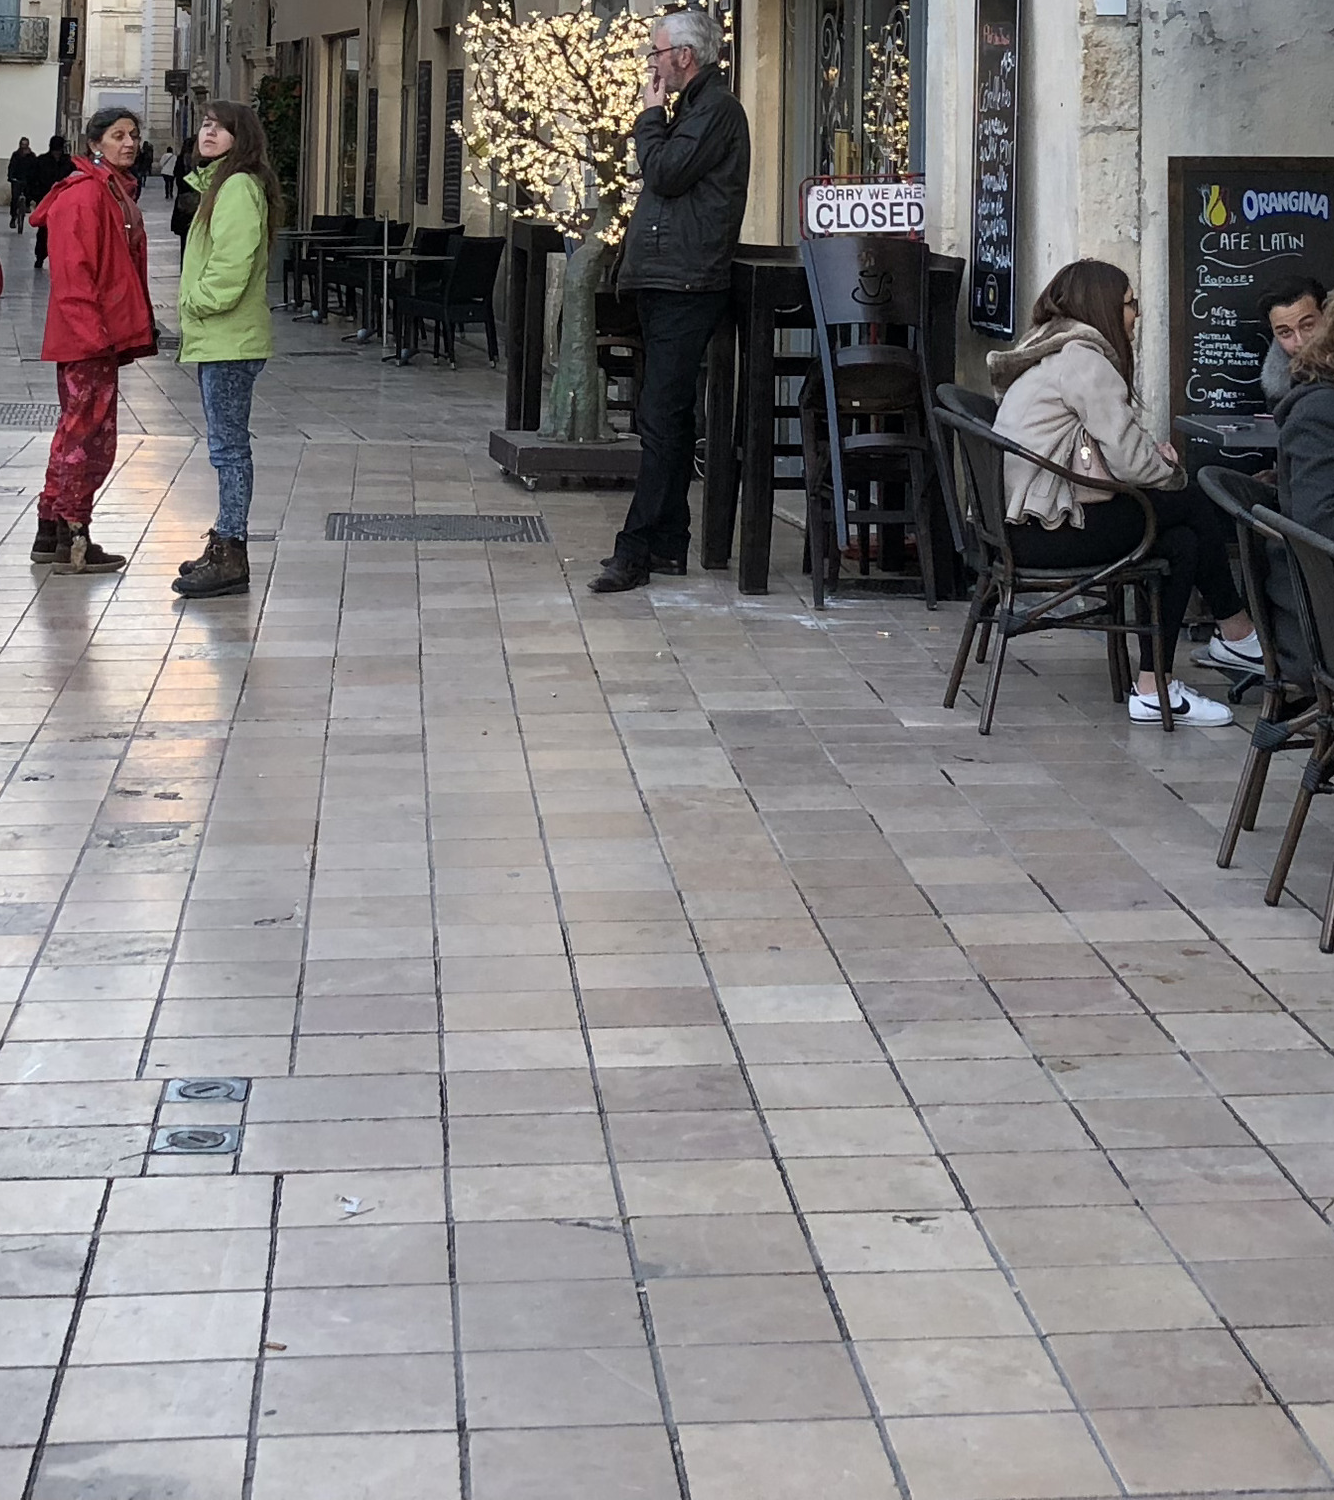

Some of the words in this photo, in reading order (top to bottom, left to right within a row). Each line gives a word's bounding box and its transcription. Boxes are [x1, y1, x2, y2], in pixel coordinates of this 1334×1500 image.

[816, 189, 863, 201] SORRY
[869, 188, 890, 201] WE
[1242, 189, 1329, 221] ORANGINA
[816, 202, 924, 229] CLOSED
[1200, 231, 1251, 254] CAFE
[1260, 233, 1304, 252] LATIN
